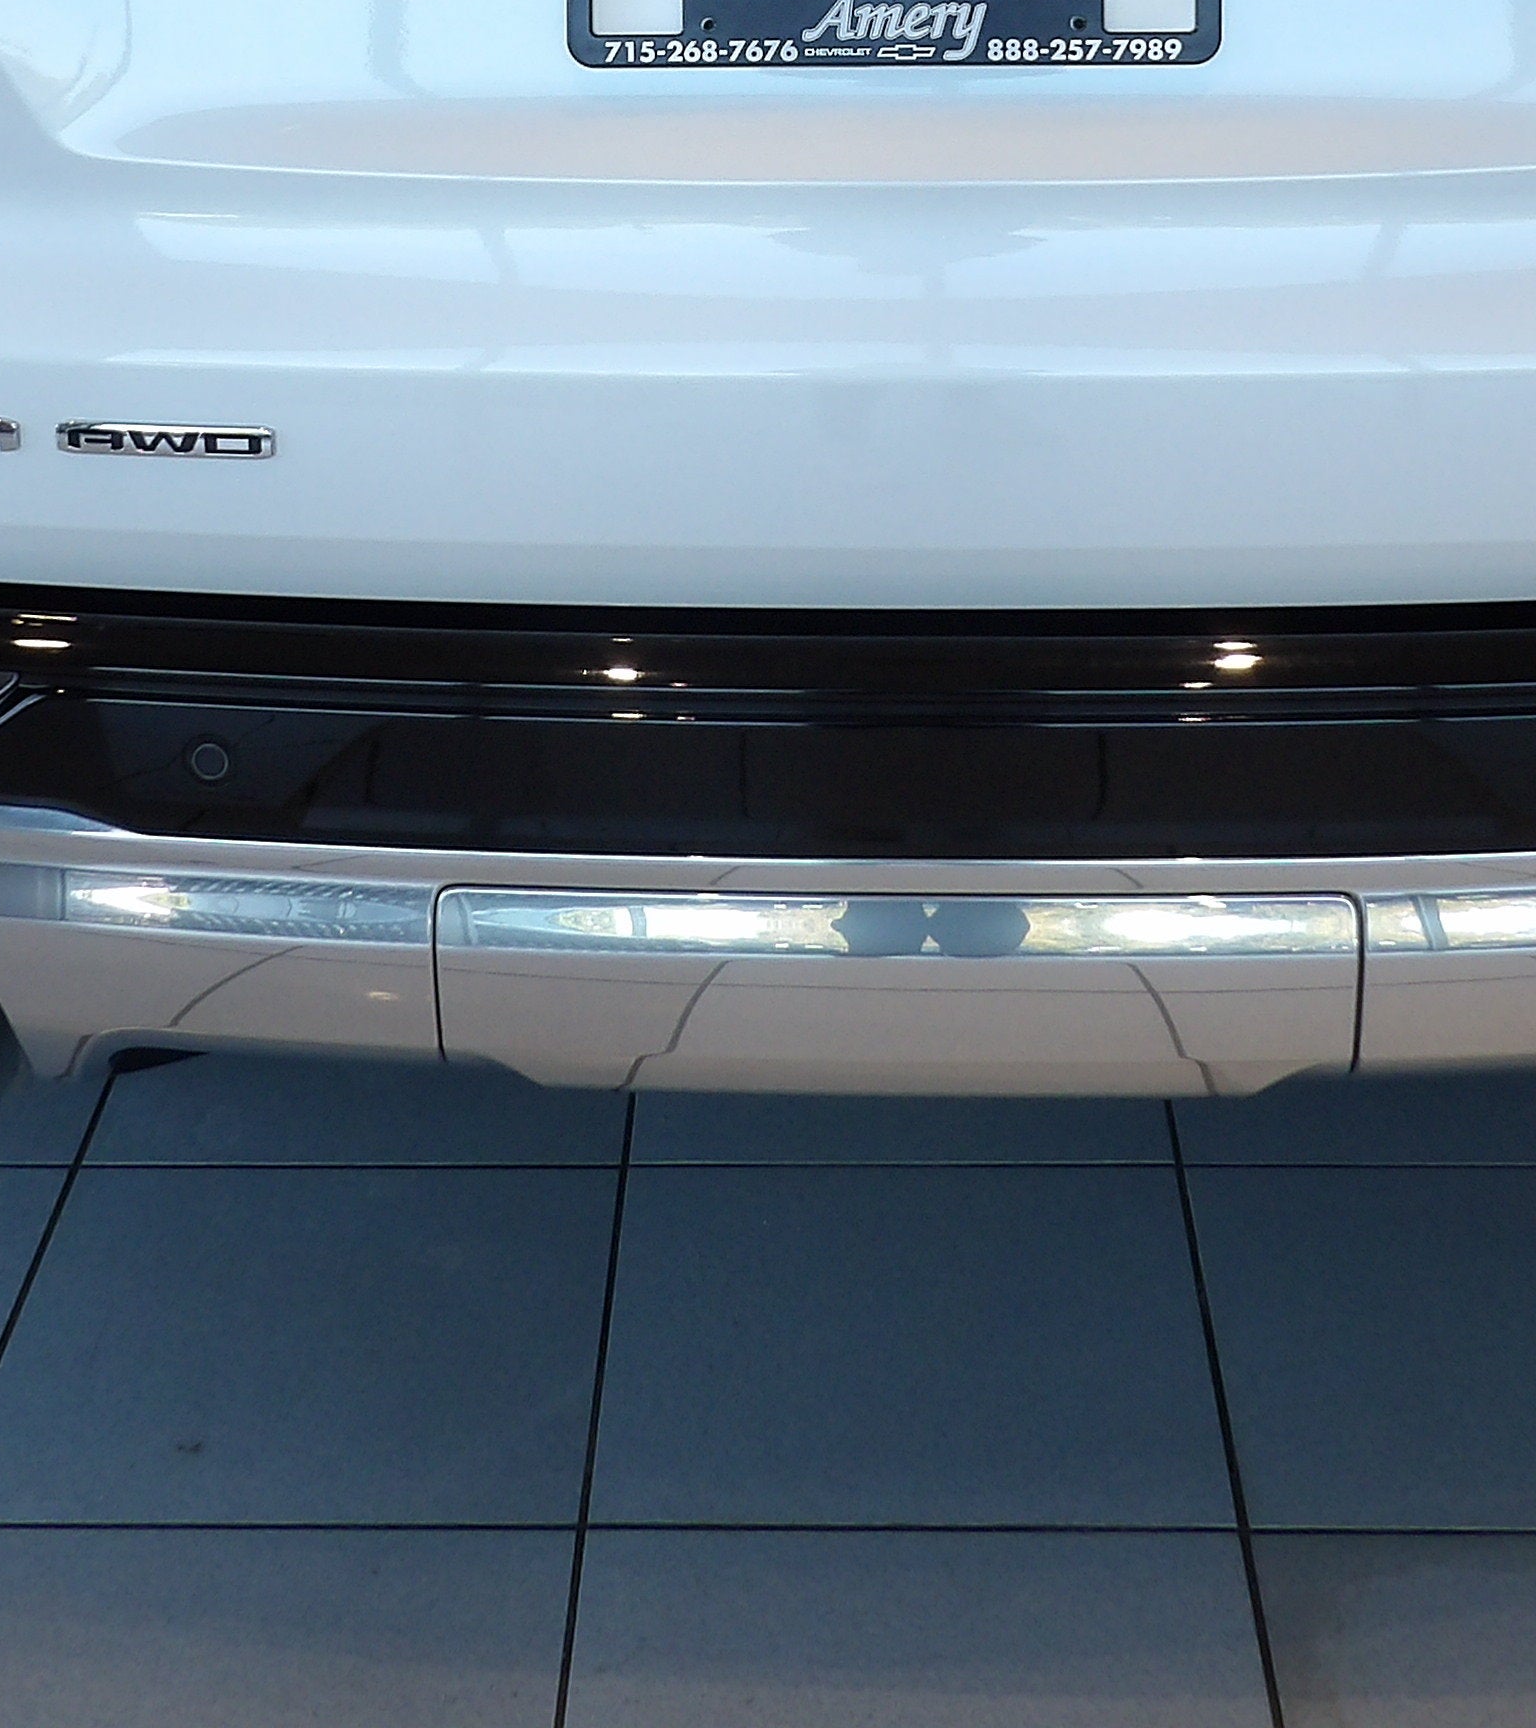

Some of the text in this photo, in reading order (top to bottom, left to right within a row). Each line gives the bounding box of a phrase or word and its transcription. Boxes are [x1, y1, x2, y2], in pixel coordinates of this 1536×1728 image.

[604, 39, 799, 64] 715-268-7676
[804, 47, 872, 57] CHEVROLET
[986, 38, 1183, 62] 888-257-7989
[61, 424, 270, 457] AWD
